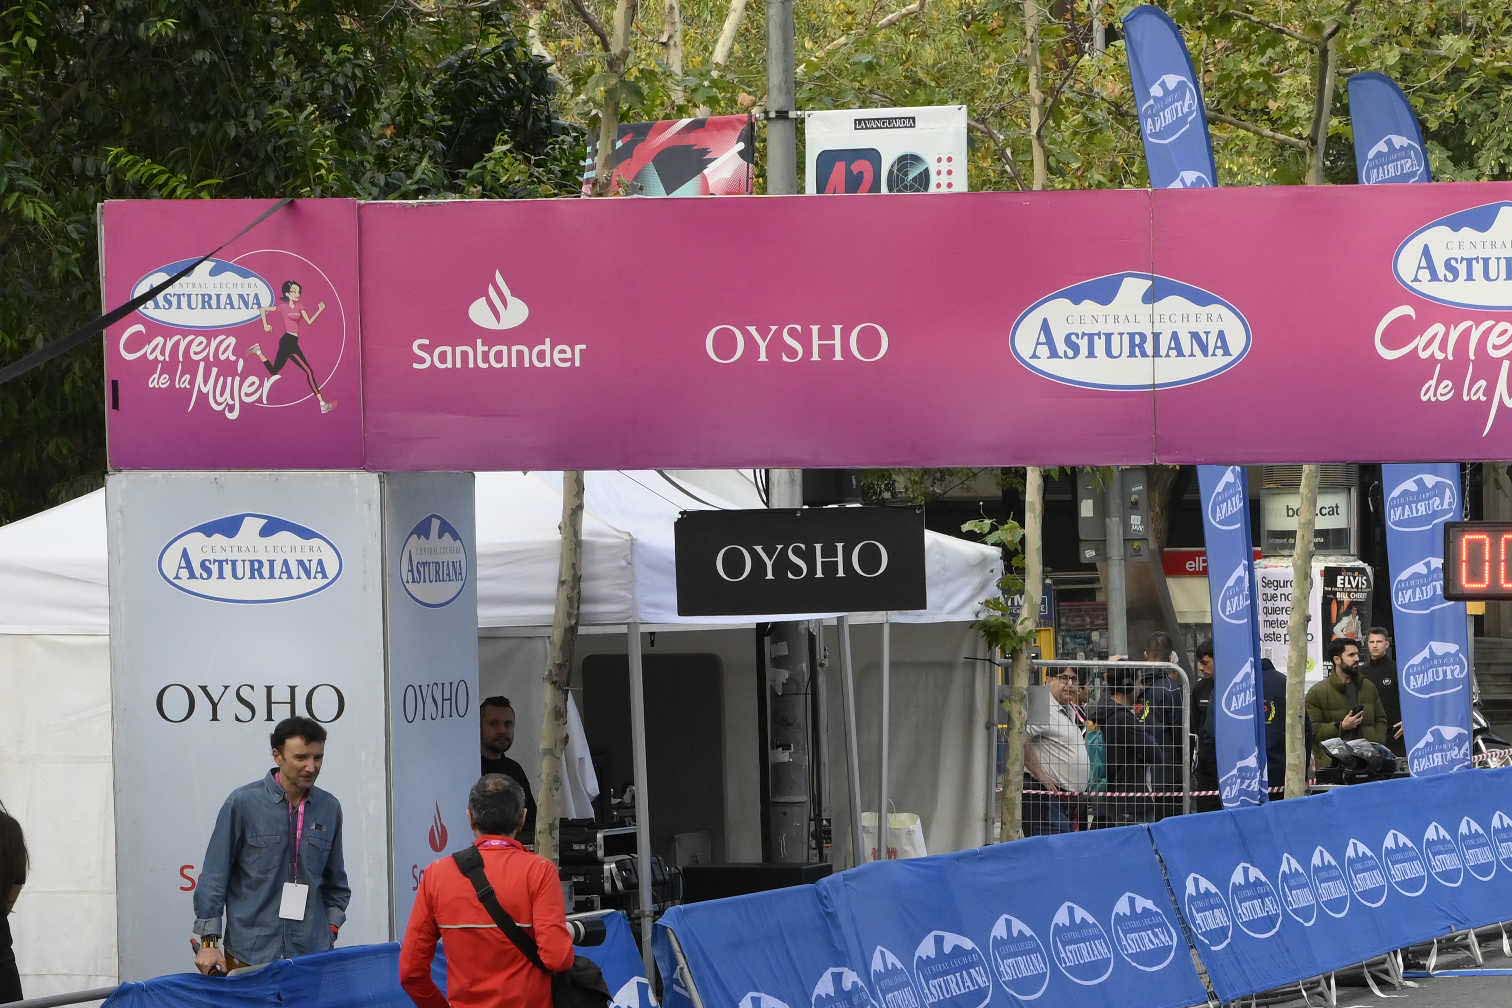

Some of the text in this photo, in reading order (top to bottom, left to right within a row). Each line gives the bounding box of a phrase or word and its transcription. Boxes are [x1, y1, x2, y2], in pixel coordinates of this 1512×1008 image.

[865, 118, 915, 129] VANGUARDIA
[824, 159, 874, 193] 42
[1066, 312, 1225, 326] CENTRAL LECHERA
[119, 323, 238, 362] Carrera
[412, 337, 587, 370] Santander
[705, 322, 889, 364] OYSHO
[1029, 317, 1233, 360] ASTURIANA
[148, 358, 282, 421] de la Mujer
[1420, 362, 1454, 402] de
[1463, 361, 1487, 402] la
[174, 546, 330, 581] ASTURIANA
[200, 544, 323, 554] CENTRAL LECHERA
[716, 540, 889, 582] OYSHO
[406, 550, 464, 585] ASTURIANA
[1337, 576, 1367, 588] ELVIS
[1262, 592, 1278, 605] que
[1263, 604, 1293, 616] quiere
[1263, 632, 1281, 642] este
[156, 683, 346, 724] OYSHO
[403, 680, 469, 724] OYSHO
[995, 951, 1047, 982] ASTURIANA
[1057, 936, 1110, 968] ASTURIANA
[920, 965, 989, 1004] ASTURIANA
